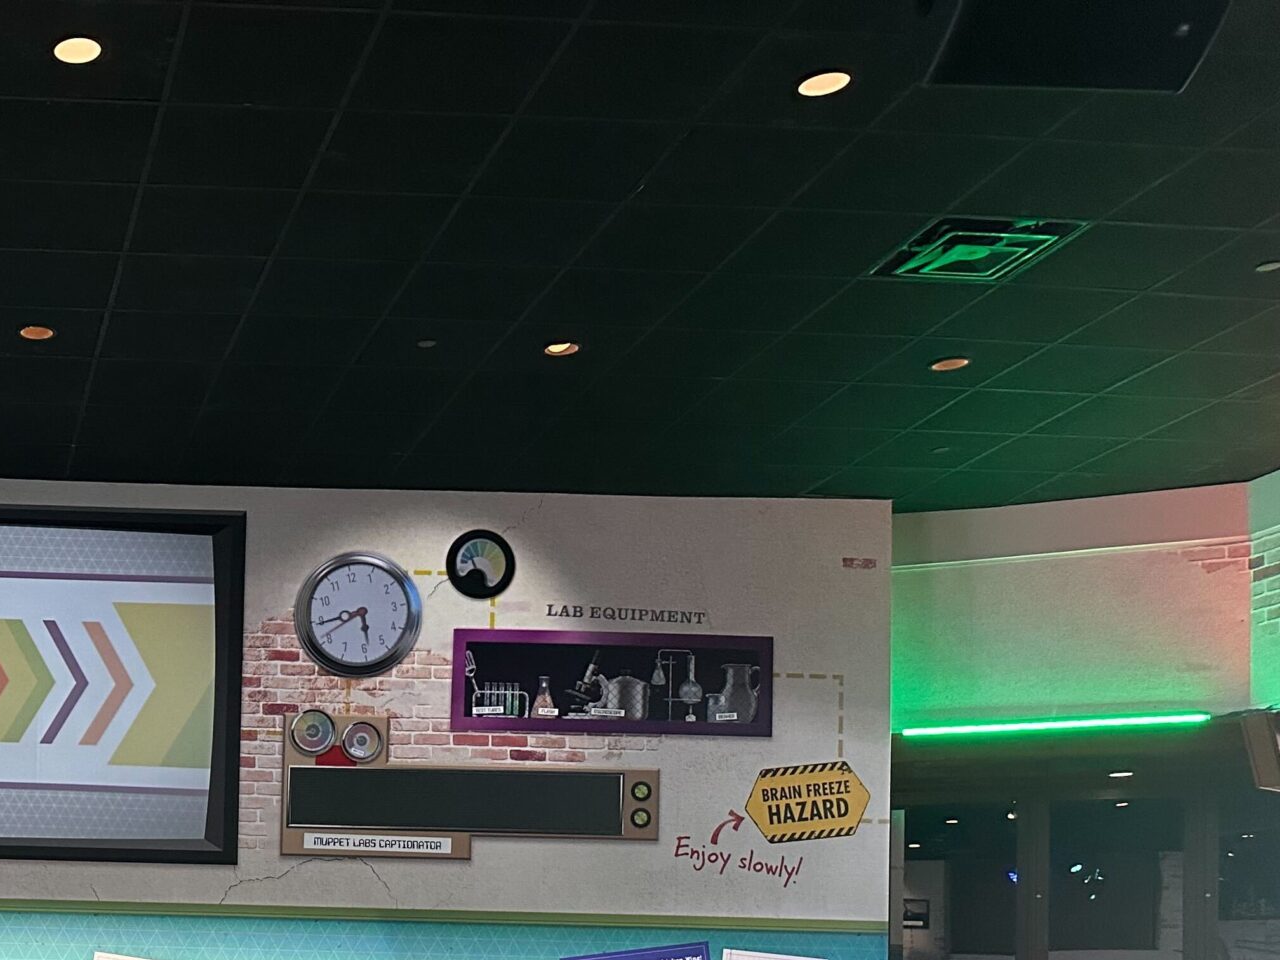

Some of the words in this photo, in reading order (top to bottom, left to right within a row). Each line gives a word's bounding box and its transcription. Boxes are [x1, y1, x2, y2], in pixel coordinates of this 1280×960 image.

[347, 573, 356, 583] 12
[330, 581, 340, 592] 11
[384, 584, 390, 595] 2
[320, 596, 330, 607] 10
[391, 602, 397, 612] 3
[546, 604, 584, 618] LAB
[589, 606, 706, 624] EQUIPMENT
[391, 621, 396, 631] 4
[326, 634, 333, 644] 8
[378, 635, 385, 645] 5
[342, 642, 348, 652] 7
[361, 644, 368, 654] 6
[761, 784, 802, 802] BRAIN
[806, 780, 851, 797] FREEZE
[767, 798, 849, 825] HAZARD
[313, 837, 350, 847] MUPPET
[353, 838, 376, 848] LABS
[378, 839, 442, 850] CAPTIONATOR
[674, 836, 731, 875] Enjoy
[738, 850, 803, 888] slowly!
